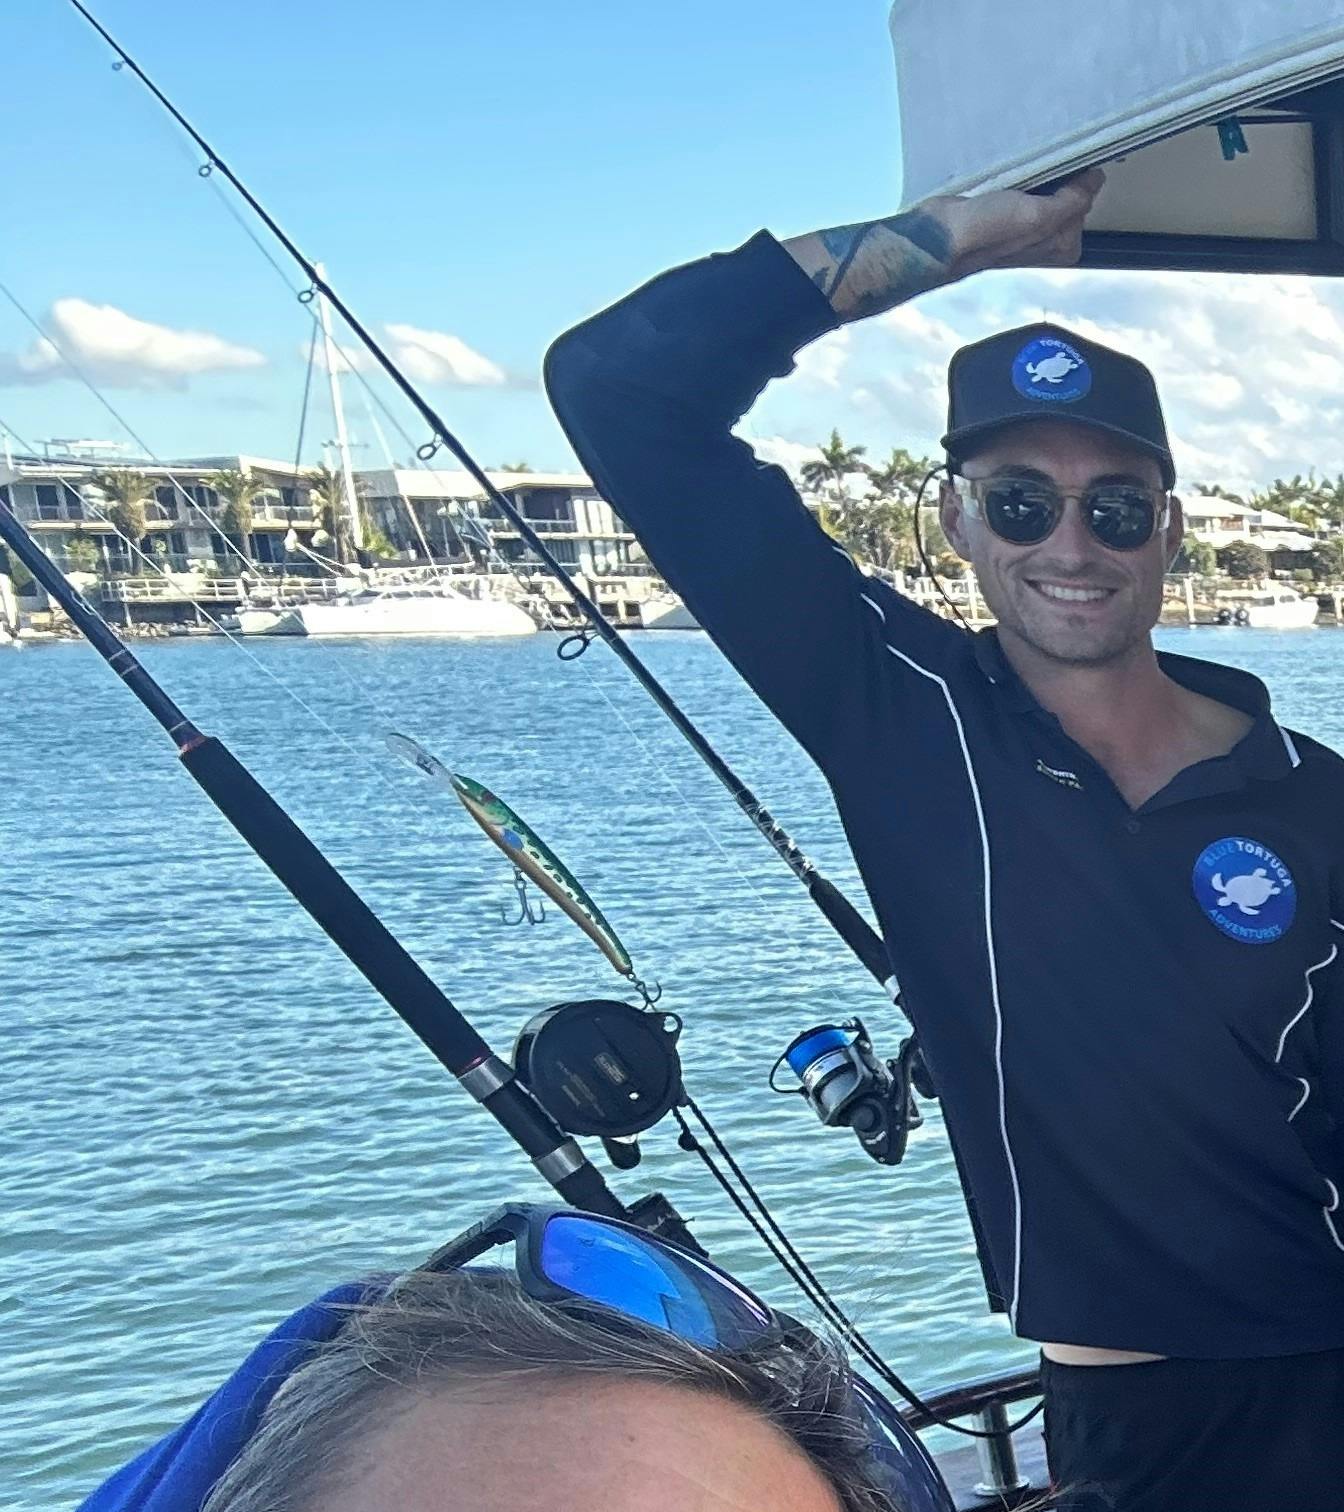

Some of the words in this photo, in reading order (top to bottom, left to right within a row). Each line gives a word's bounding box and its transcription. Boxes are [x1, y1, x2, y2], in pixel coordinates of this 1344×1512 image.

[1203, 841, 1237, 867] BLUE
[1235, 840, 1292, 888] TORTUGA
[1209, 909, 1282, 940] ADVENTURES
